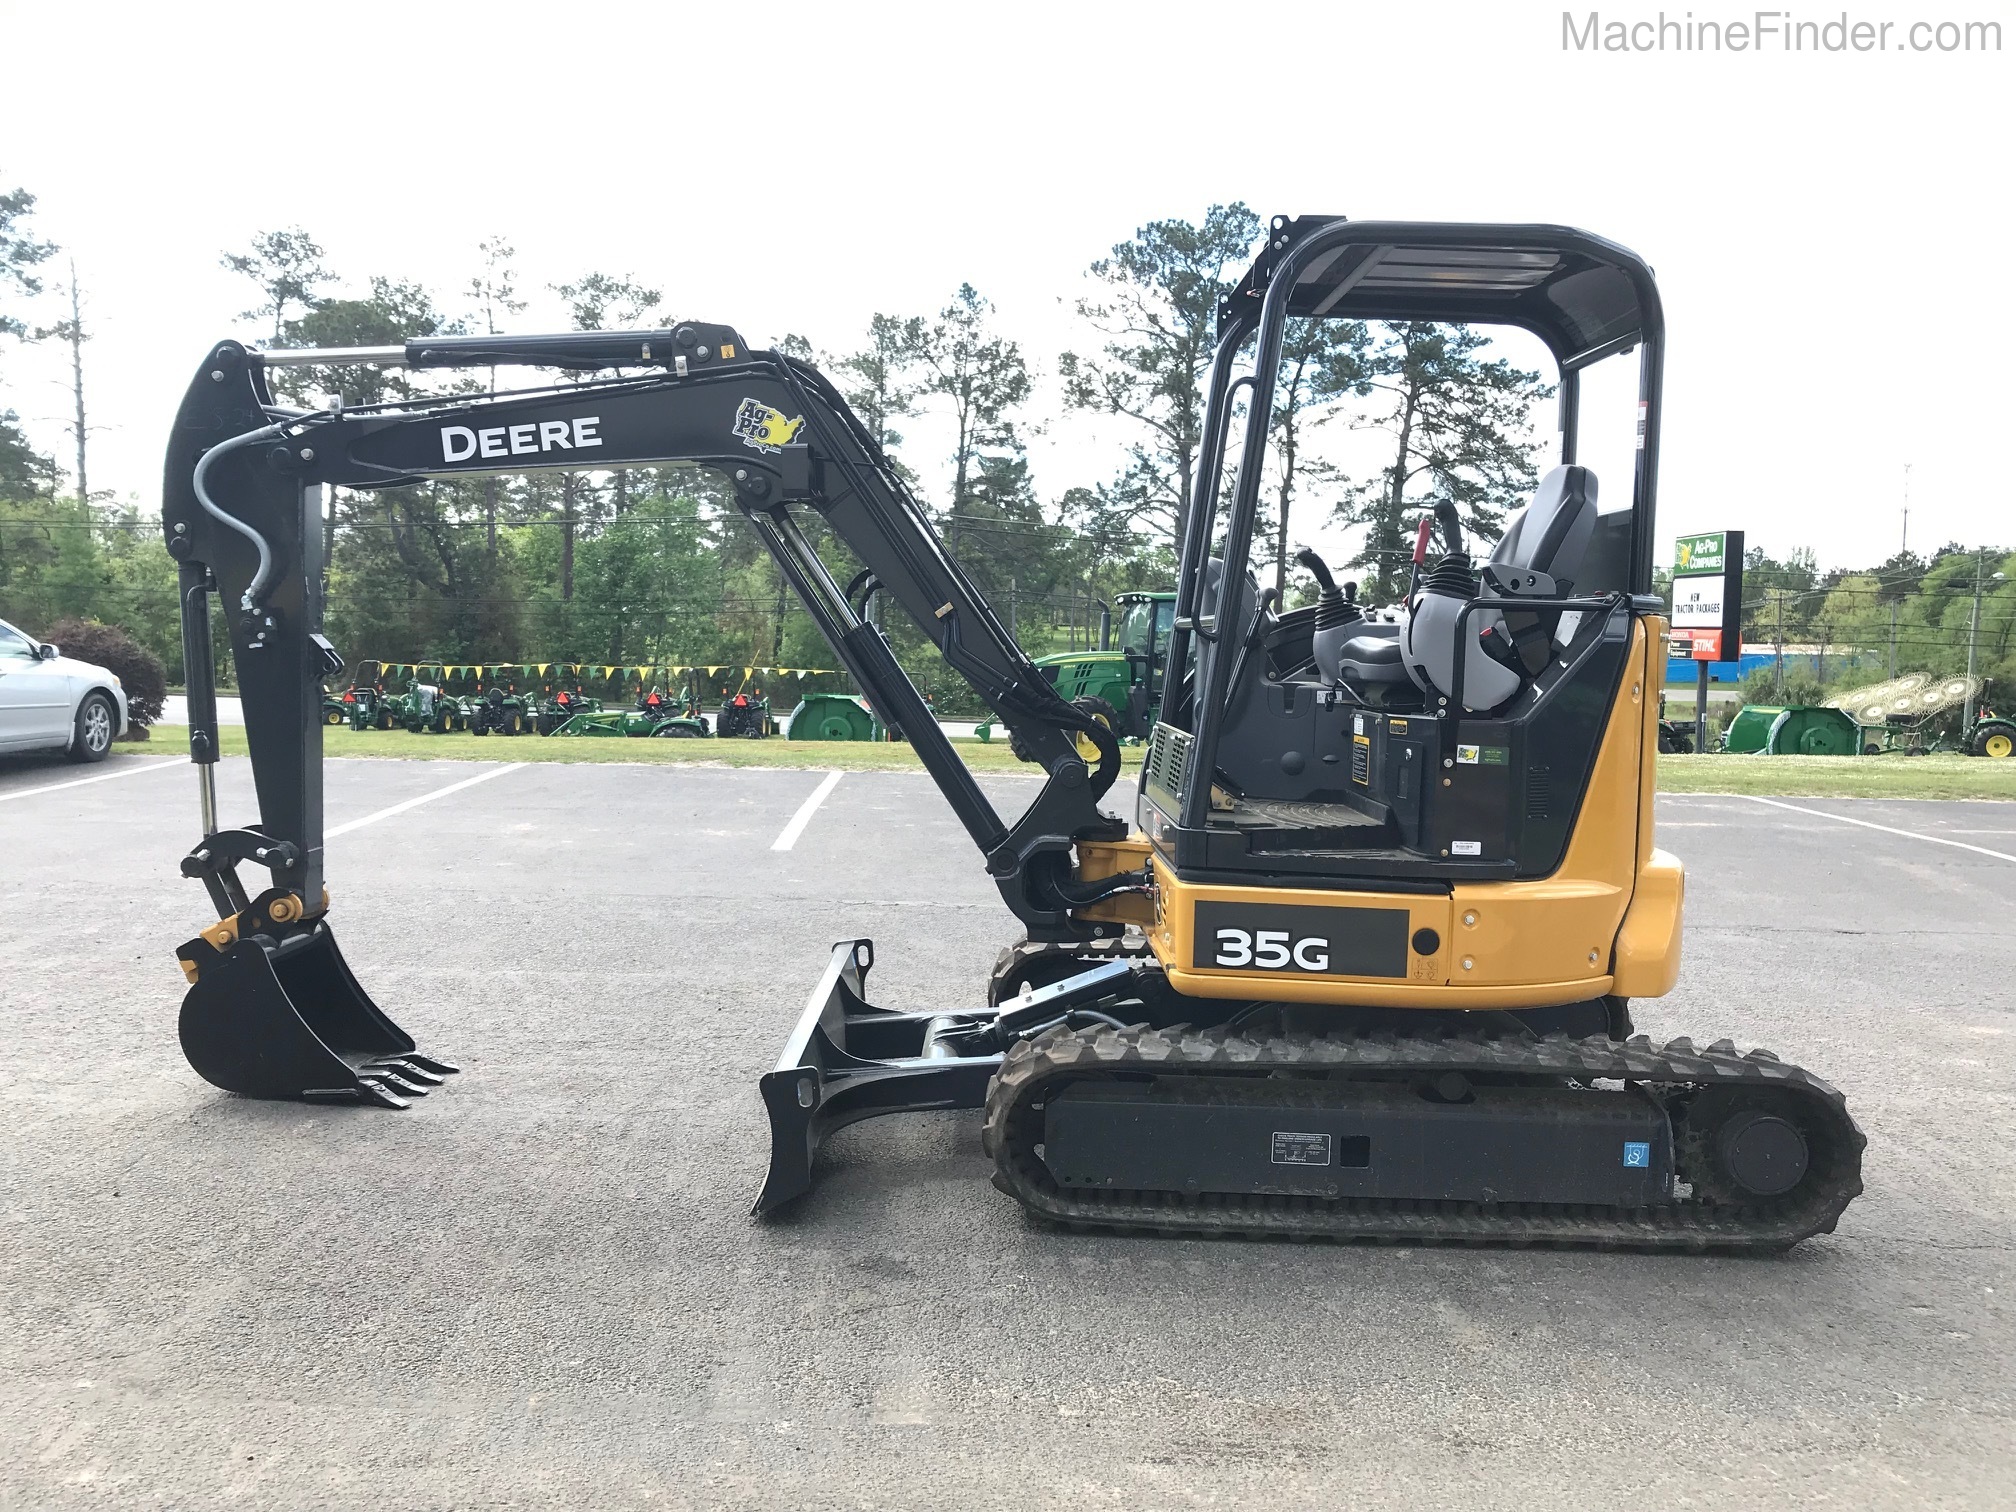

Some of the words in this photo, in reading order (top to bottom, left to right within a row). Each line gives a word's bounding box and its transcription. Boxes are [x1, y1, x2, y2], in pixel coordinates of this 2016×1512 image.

[739, 401, 775, 425] Ag-
[736, 417, 770, 439] Pro
[440, 416, 603, 463] DEERE
[1675, 604, 1695, 614] TRACTOR
[1696, 603, 1720, 613] PACKAGES
[1690, 593, 1701, 602] NEW
[1693, 638, 1716, 653] STIHL
[1216, 928, 1329, 971] 35G
